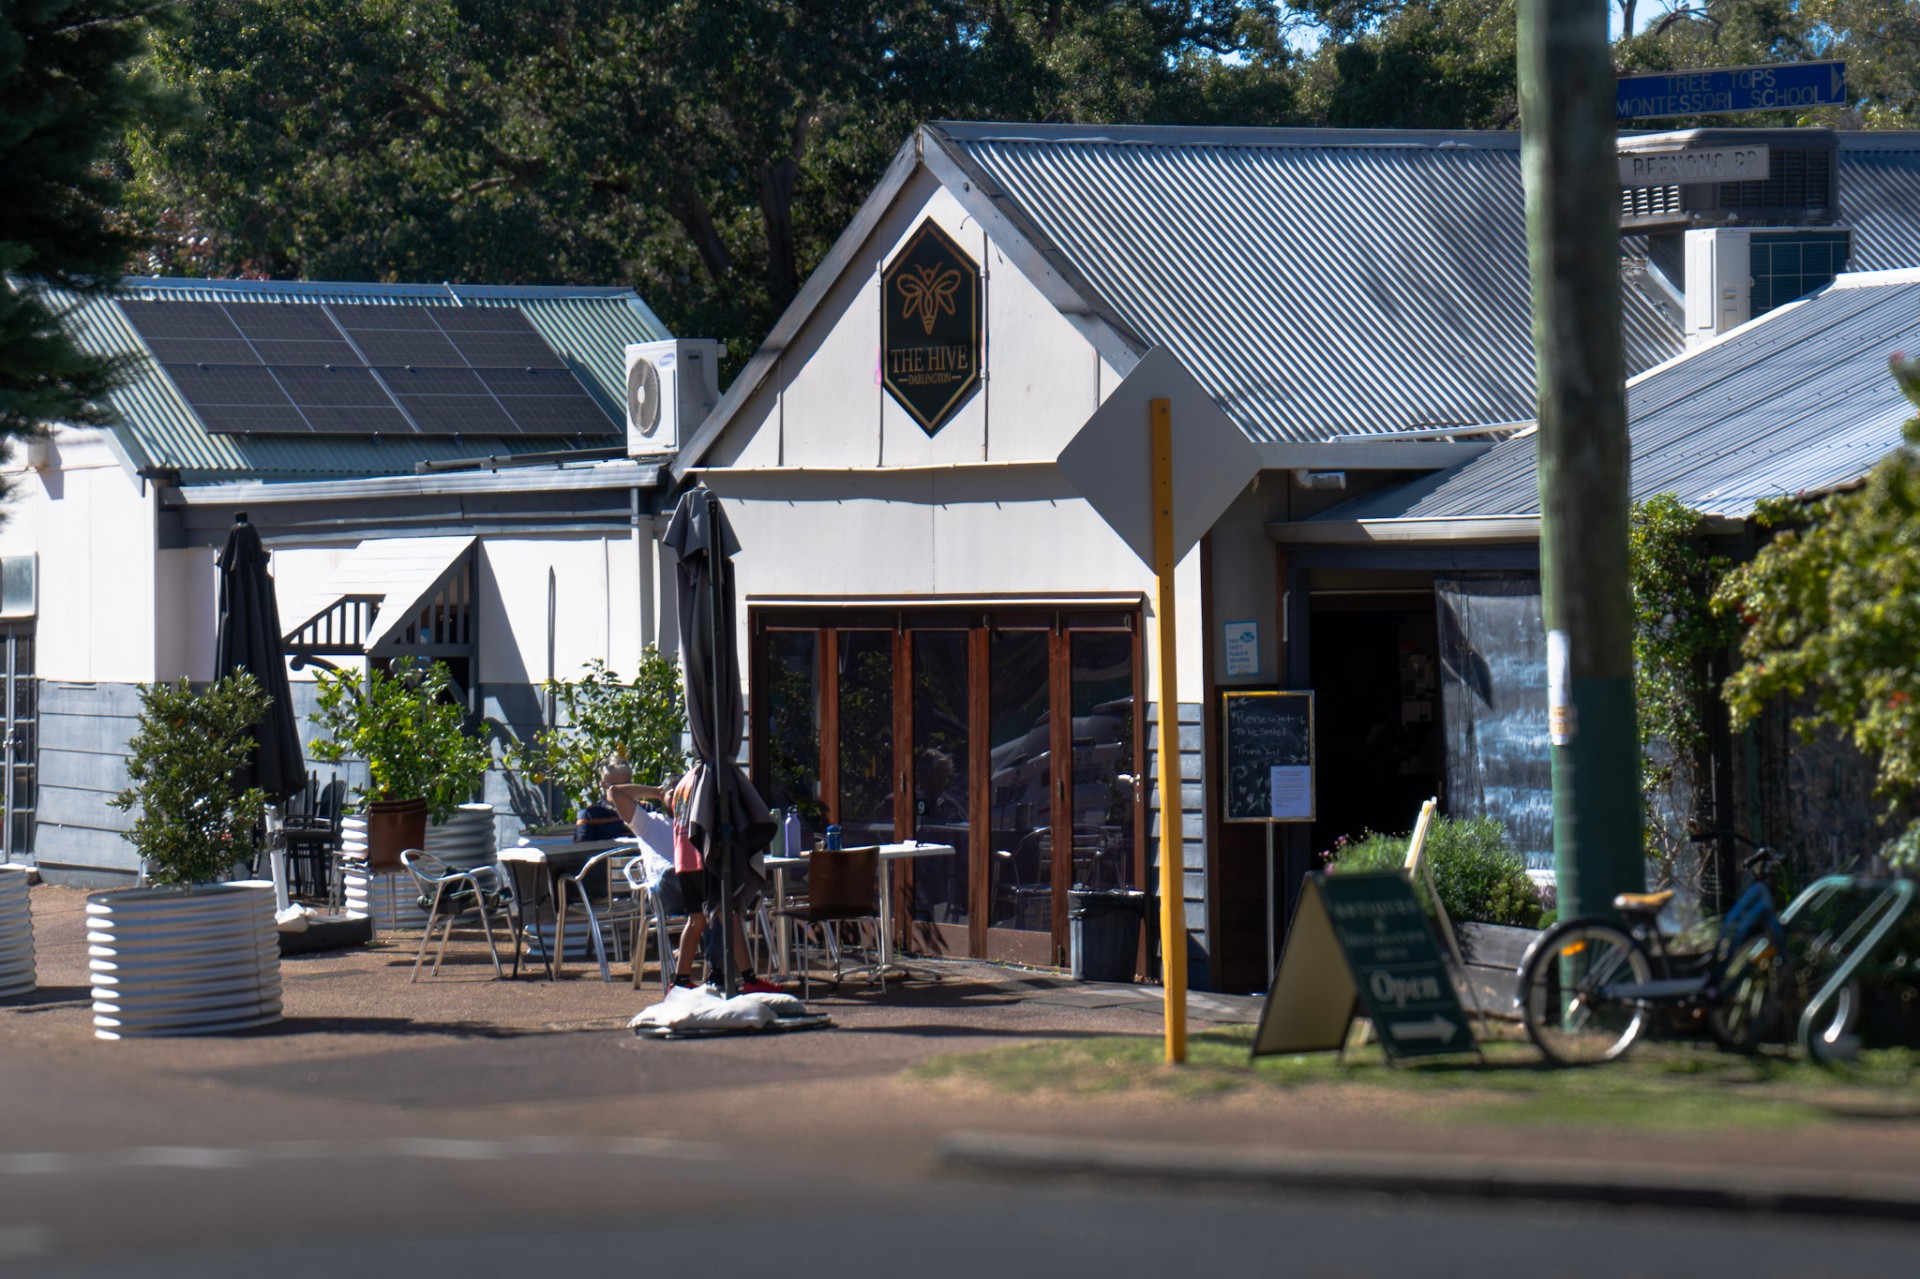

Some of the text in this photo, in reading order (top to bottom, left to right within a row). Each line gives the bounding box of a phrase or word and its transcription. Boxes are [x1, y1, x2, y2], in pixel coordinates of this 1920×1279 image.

[1665, 69, 1776, 93] TREE TOPS
[1617, 85, 1826, 116] MONTESSORI SCHOOL
[890, 345, 968, 374] THE HIVE
[908, 373, 953, 386] DARLINGTON
[917, 800, 926, 815] 9
[1370, 969, 1441, 1009] Open
